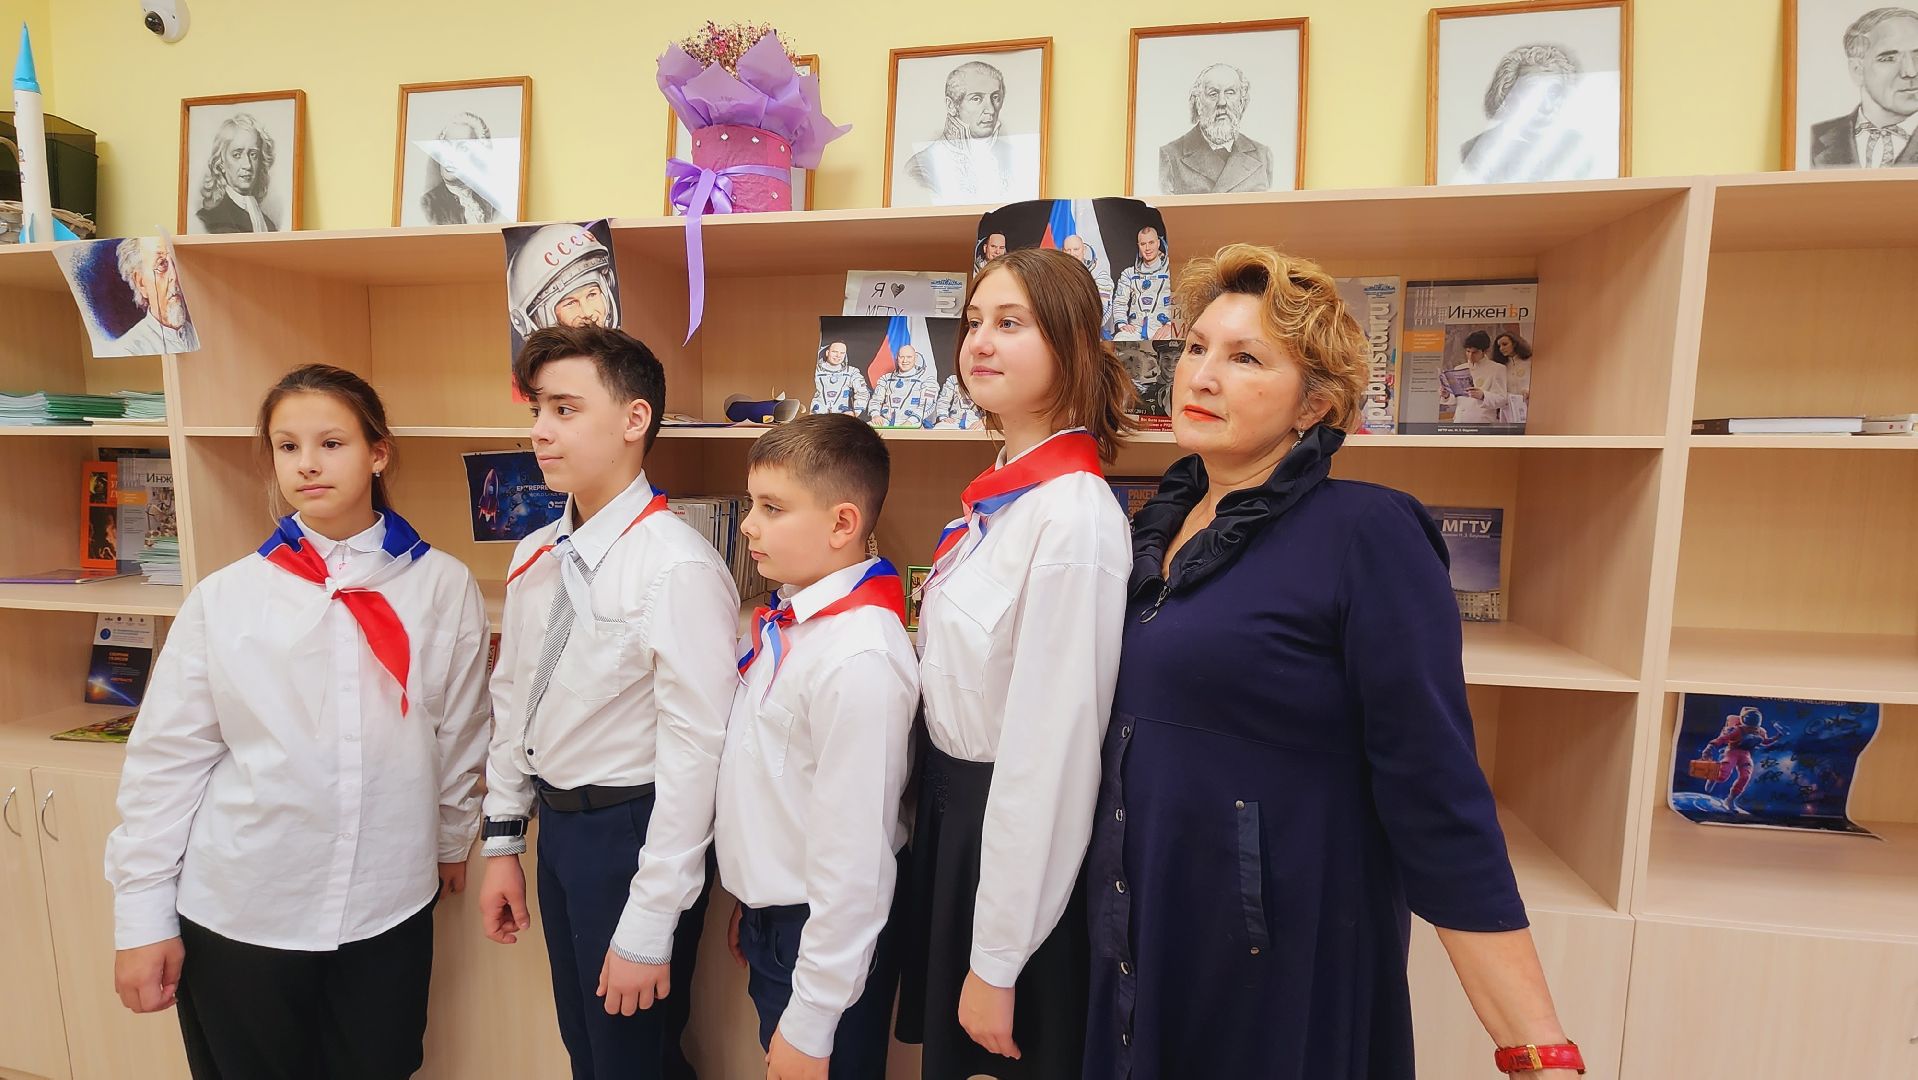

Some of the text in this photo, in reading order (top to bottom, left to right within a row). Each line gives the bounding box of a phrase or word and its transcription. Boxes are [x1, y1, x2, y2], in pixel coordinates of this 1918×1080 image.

[871, 282, 886, 298] Я
[146, 472, 174, 483] Инж
[1442, 519, 1492, 534] МГТУ
